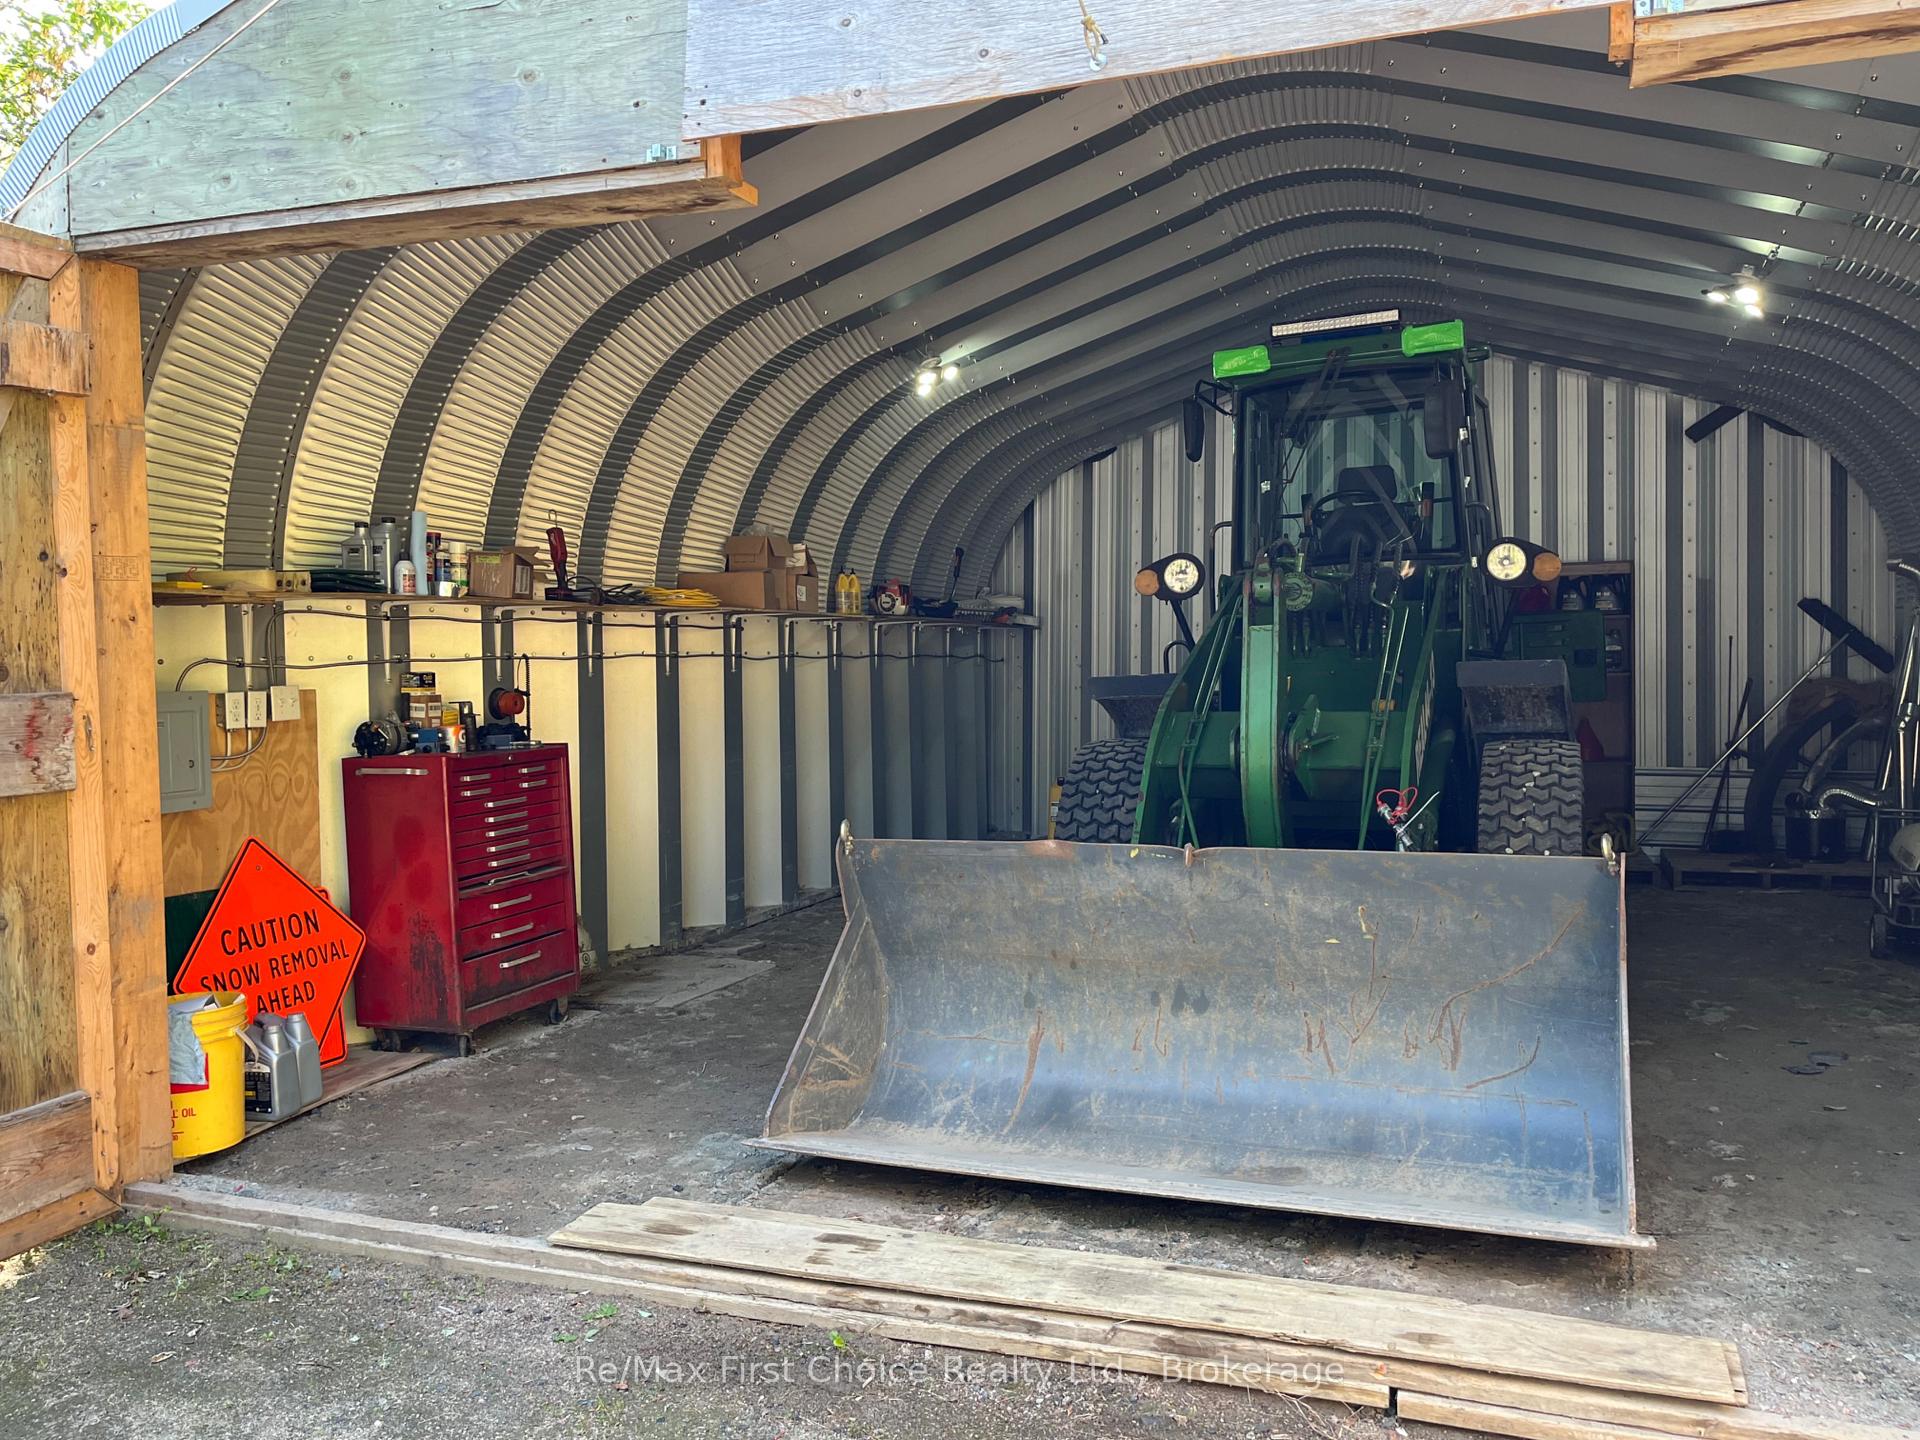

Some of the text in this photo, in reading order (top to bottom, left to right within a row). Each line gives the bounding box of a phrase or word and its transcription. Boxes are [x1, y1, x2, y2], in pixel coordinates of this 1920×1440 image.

[220, 909, 320, 956] CAUTION
[200, 939, 350, 992] SNOW REMOVAL
[257, 980, 316, 1013] AHEAD
[181, 1107, 197, 1118] OIL
